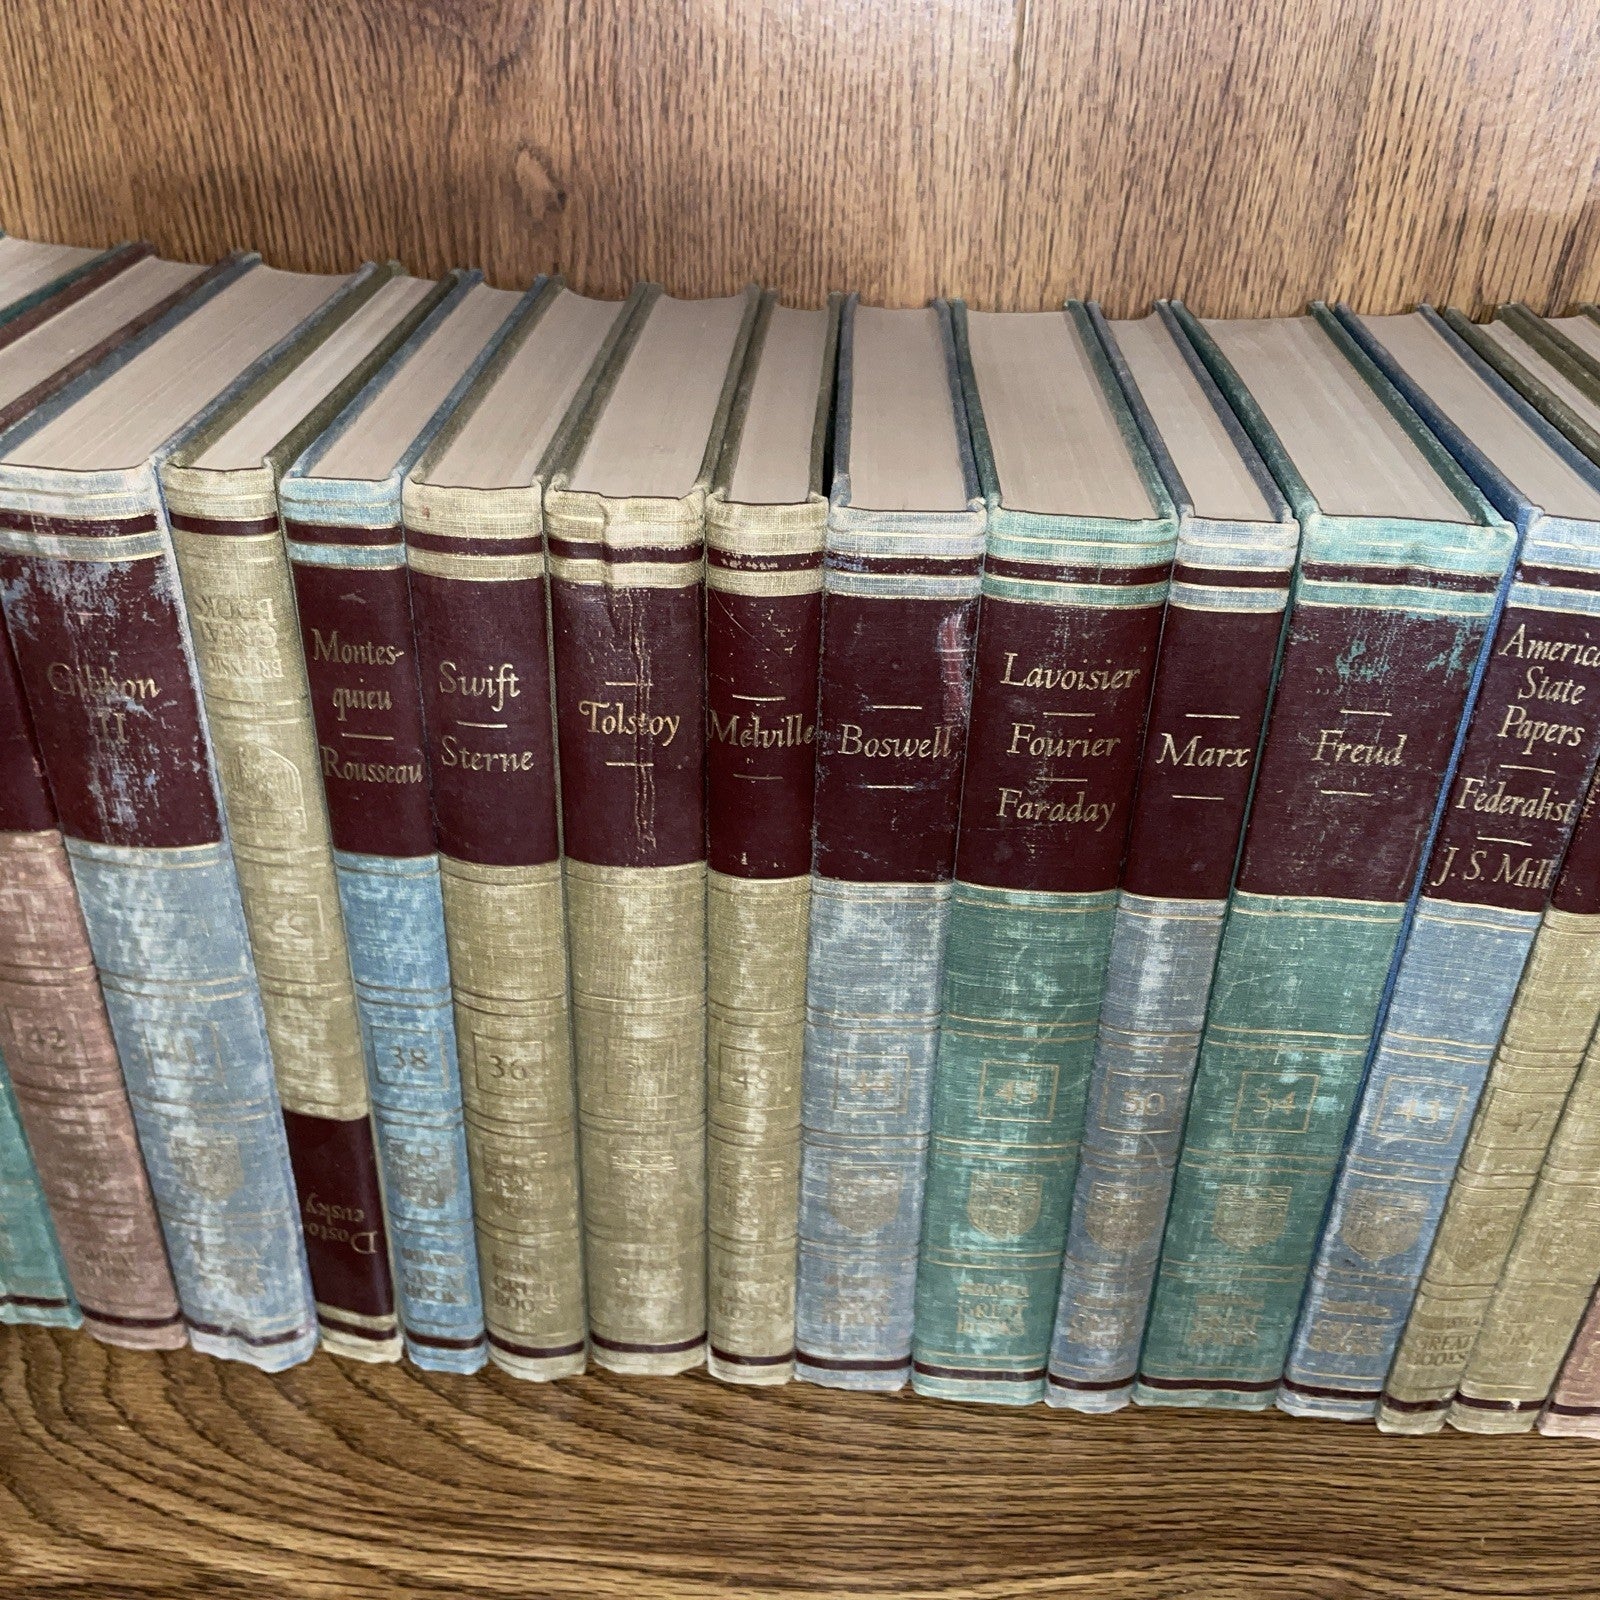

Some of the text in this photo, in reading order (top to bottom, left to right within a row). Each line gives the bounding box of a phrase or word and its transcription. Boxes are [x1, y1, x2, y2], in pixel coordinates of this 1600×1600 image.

[311, 628, 405, 665] Montes-
[439, 661, 520, 711] Swift
[1000, 652, 1141, 690] Lavoisier
[1517, 665, 1586, 705] State
[578, 700, 680, 747] Tolstoy
[706, 709, 815, 749] Melville
[837, 723, 952, 759] Boswell
[1006, 722, 1121, 758] Fourier
[1497, 705, 1586, 755] Papers
[321, 745, 424, 784] Rousseau
[441, 735, 534, 772] Sterne
[1155, 732, 1251, 768] Marx
[1311, 729, 1408, 766] Freud
[996, 788, 1116, 832] Faraday
[1455, 777, 1576, 825] Federalist
[1430, 846, 1557, 891] J. S. Mill
[389, 1045, 428, 1072] 38
[488, 1054, 529, 1081] 36
[1119, 1089, 1165, 1116] 50
